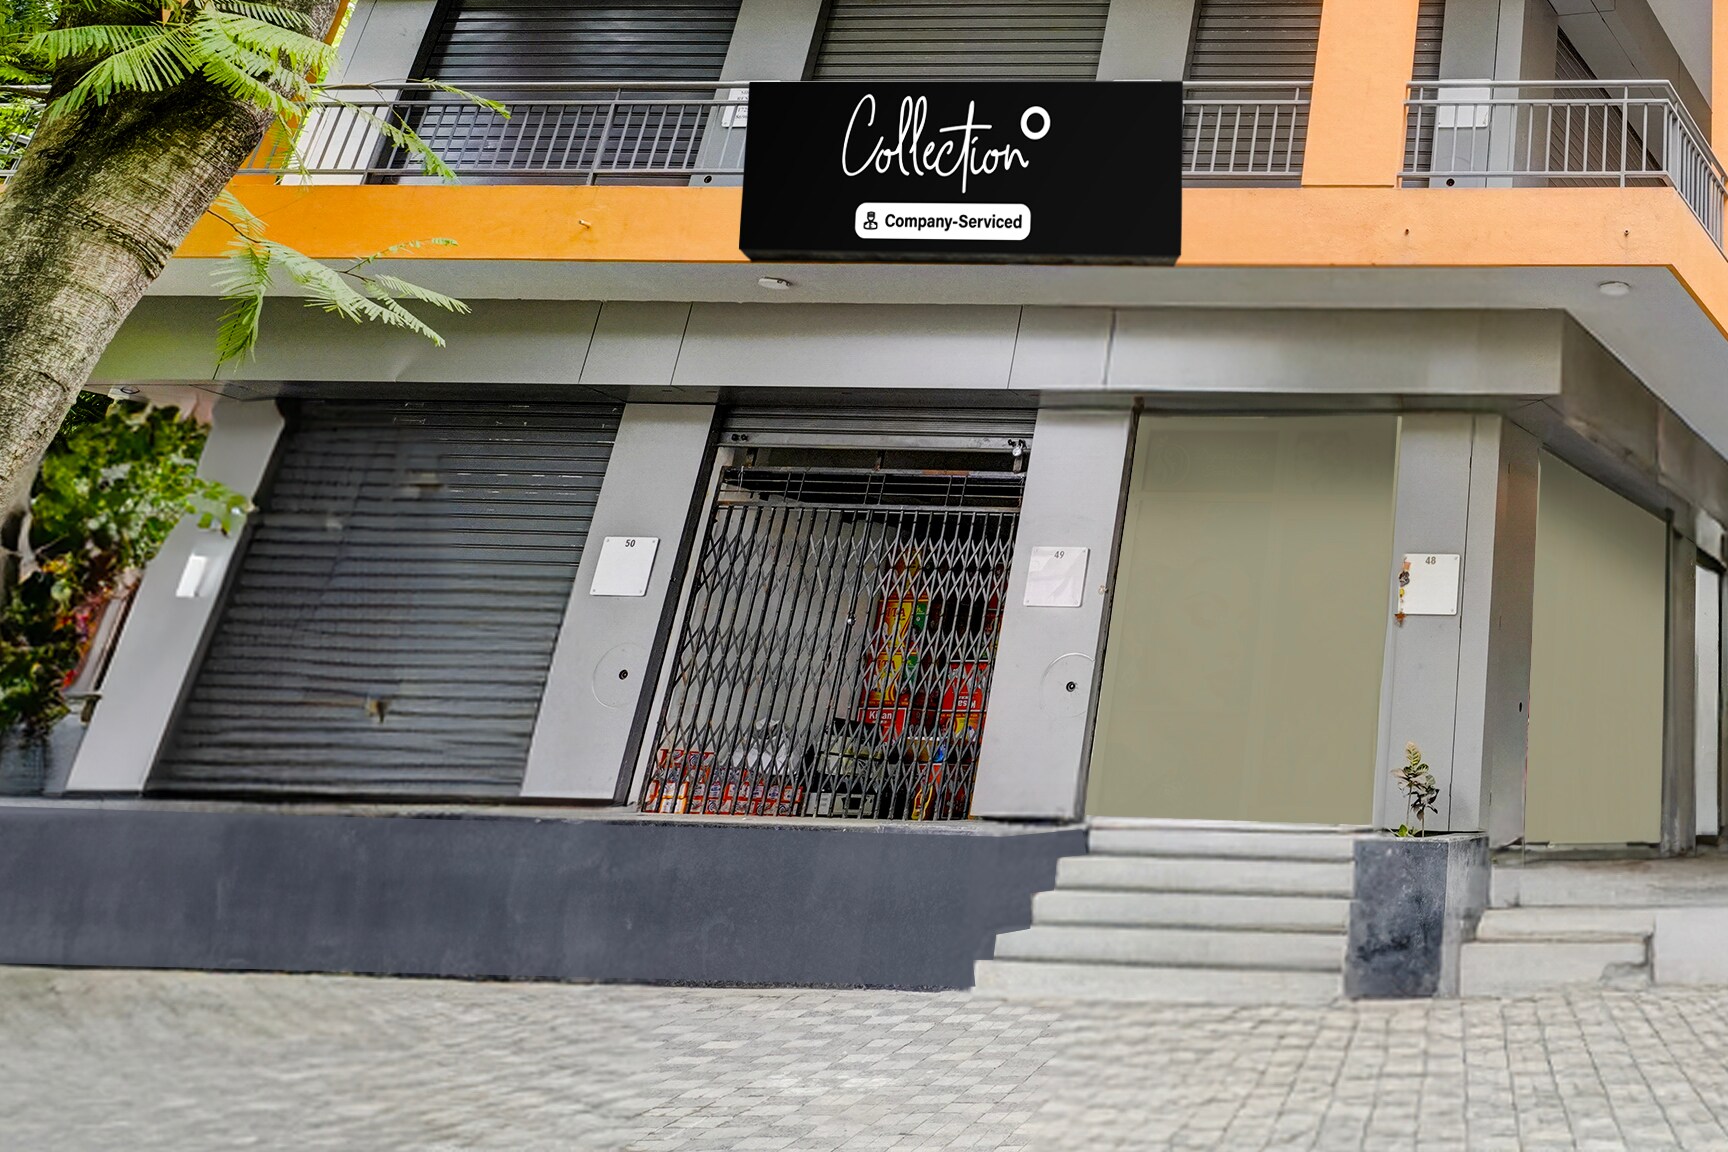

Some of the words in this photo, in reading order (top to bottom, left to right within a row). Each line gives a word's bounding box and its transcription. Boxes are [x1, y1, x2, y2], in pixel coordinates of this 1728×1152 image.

[842, 94, 1029, 194] Collection
[885, 214, 1022, 231] Company-Serviced
[625, 539, 636, 547] 50
[1054, 550, 1065, 559] 49
[1425, 556, 1437, 565] 48
